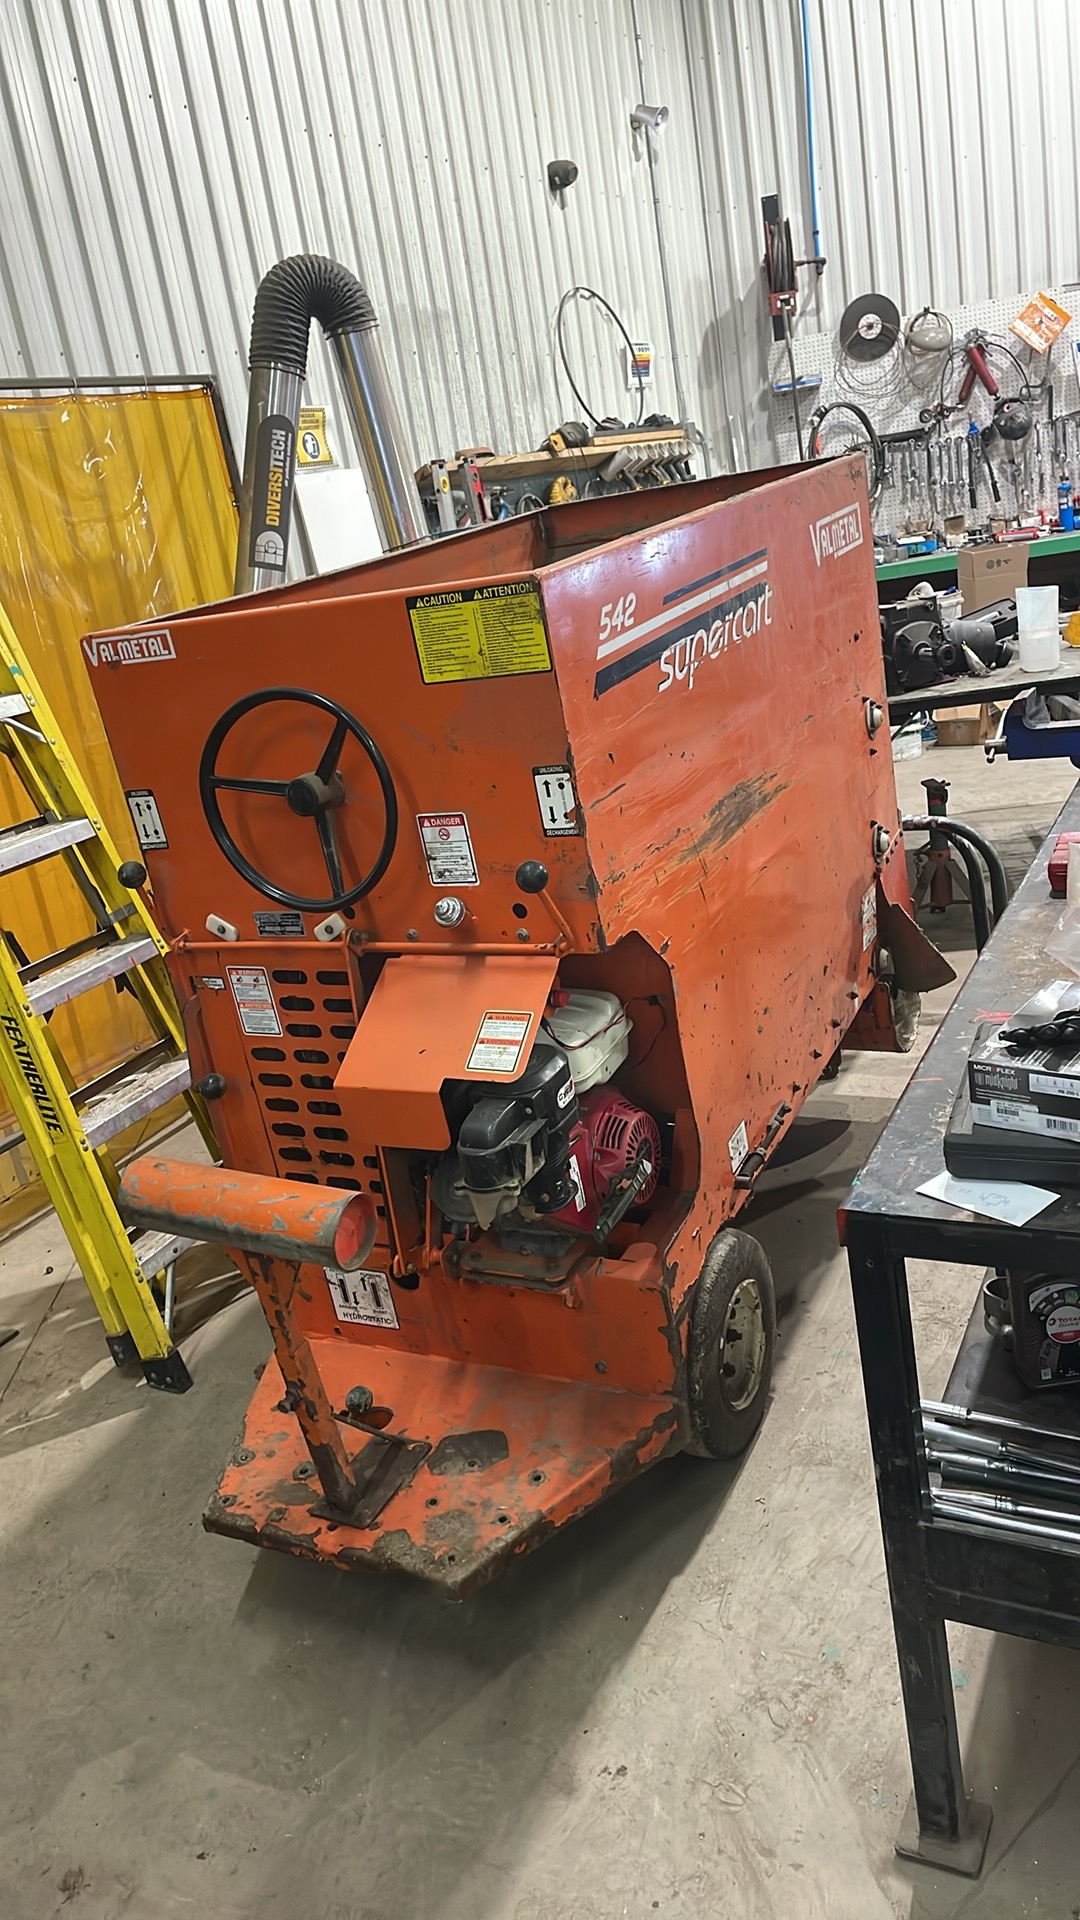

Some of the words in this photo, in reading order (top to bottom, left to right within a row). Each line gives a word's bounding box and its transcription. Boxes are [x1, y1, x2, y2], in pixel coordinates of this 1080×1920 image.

[265, 428, 286, 527] DIVERSITECH
[809, 505, 862, 566] VALMETAL
[423, 592, 463, 607] CAUTION
[482, 582, 534, 599] ATTENTION
[599, 592, 637, 641] 542
[83, 632, 172, 667] VALMETAL
[657, 583, 773, 693] supercart
[430, 817, 461, 827] DANGER
[0, 1014, 64, 1135] FEATHERLITE
[342, 1311, 394, 1325] HYDROSTATIC
[1057, 1316, 1080, 1324] TOTA
